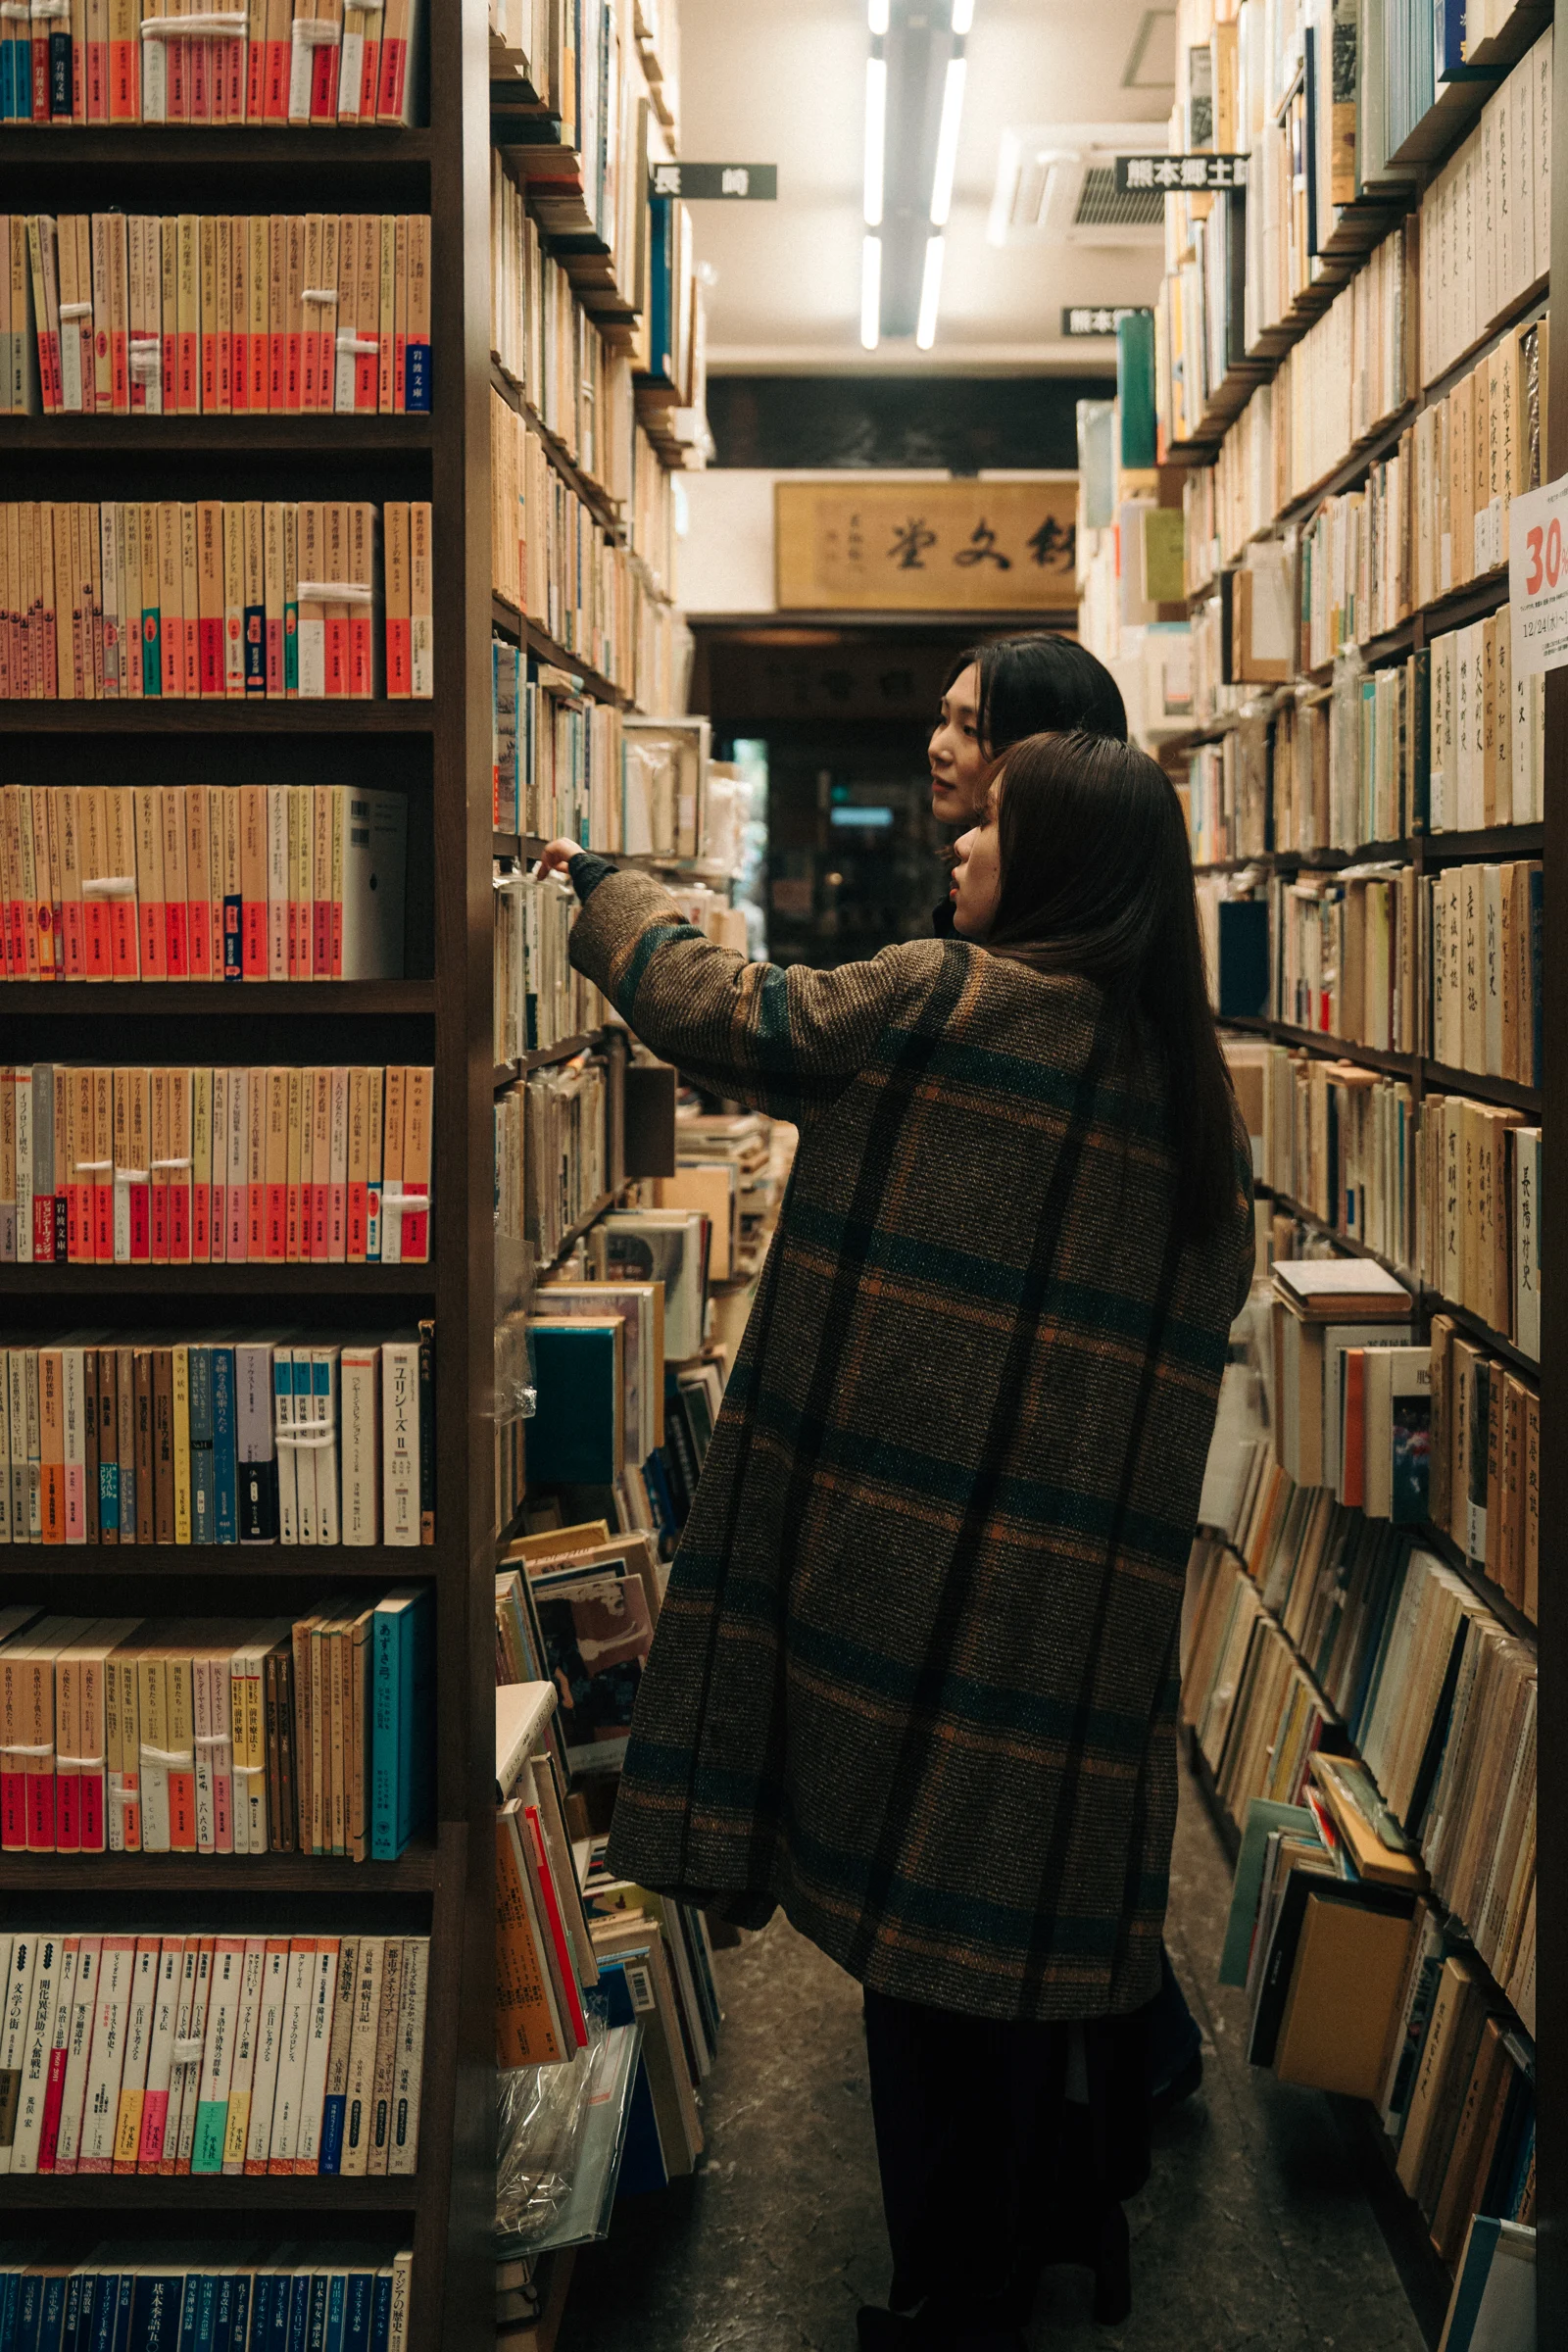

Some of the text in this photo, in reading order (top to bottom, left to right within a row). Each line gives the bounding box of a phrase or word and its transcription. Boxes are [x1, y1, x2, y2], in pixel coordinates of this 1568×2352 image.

[655, 166, 750, 197] 長崎
[413, 350, 423, 399] 岩波文庫
[390, 1074, 399, 1106] 緑の家
[414, 1074, 422, 1106] 緑の家
[56, 1202, 67, 1250] 岩波文庫
[1521, 1166, 1531, 1291] 長陽村史
[299, 1397, 308, 1437] 世界風史
[318, 1397, 326, 1437] 世界風史
[393, 1368, 409, 1433] ユリシーズ
[4, 1666, 14, 1728] 真夜中の子供たち
[32, 1666, 42, 1728] 真夜中の子供たち
[62, 1667, 71, 1700] 大使たち
[85, 1667, 94, 1700] 大使たち
[107, 1664, 117, 1703] 陶淵明全集
[123, 1666, 132, 1705] 陶淵明全集
[147, 1667, 157, 1707] 開拓者たち
[173, 1666, 182, 1705] 開拓者たち
[195, 1667, 206, 1724] 灰とダイヤモンド
[214, 1667, 223, 1724] 灰とダイヤモンド
[233, 1708, 243, 1743] 前世療法
[340, 1948, 355, 2004] 東京物語考
[9, 1982, 24, 2032] 文学の街
[158, 2005, 170, 2032] 朱子伝
[314, 2006, 326, 2039] 韓国の食
[358, 1979, 373, 2023] 闘病日記
[28, 1979, 51, 2080] 開化異国助っ人奮戦記
[54, 2005, 69, 2048] 政治と思想
[73, 2005, 86, 2056] 奥の細道吟行
[131, 2004, 145, 2061] 「在日」を考える
[212, 2017, 226, 2078] 洛中洛外の群像
[238, 2006, 253, 2060] マクルーハン理論
[264, 2005, 276, 2063] 「在日」を考える
[289, 2005, 302, 2063] アラビアのロレンス
[67, 2280, 79, 2331] 日本語の変遷
[121, 2279, 130, 2306] 禅の道
[392, 2270, 407, 2334] アジアの歴史
